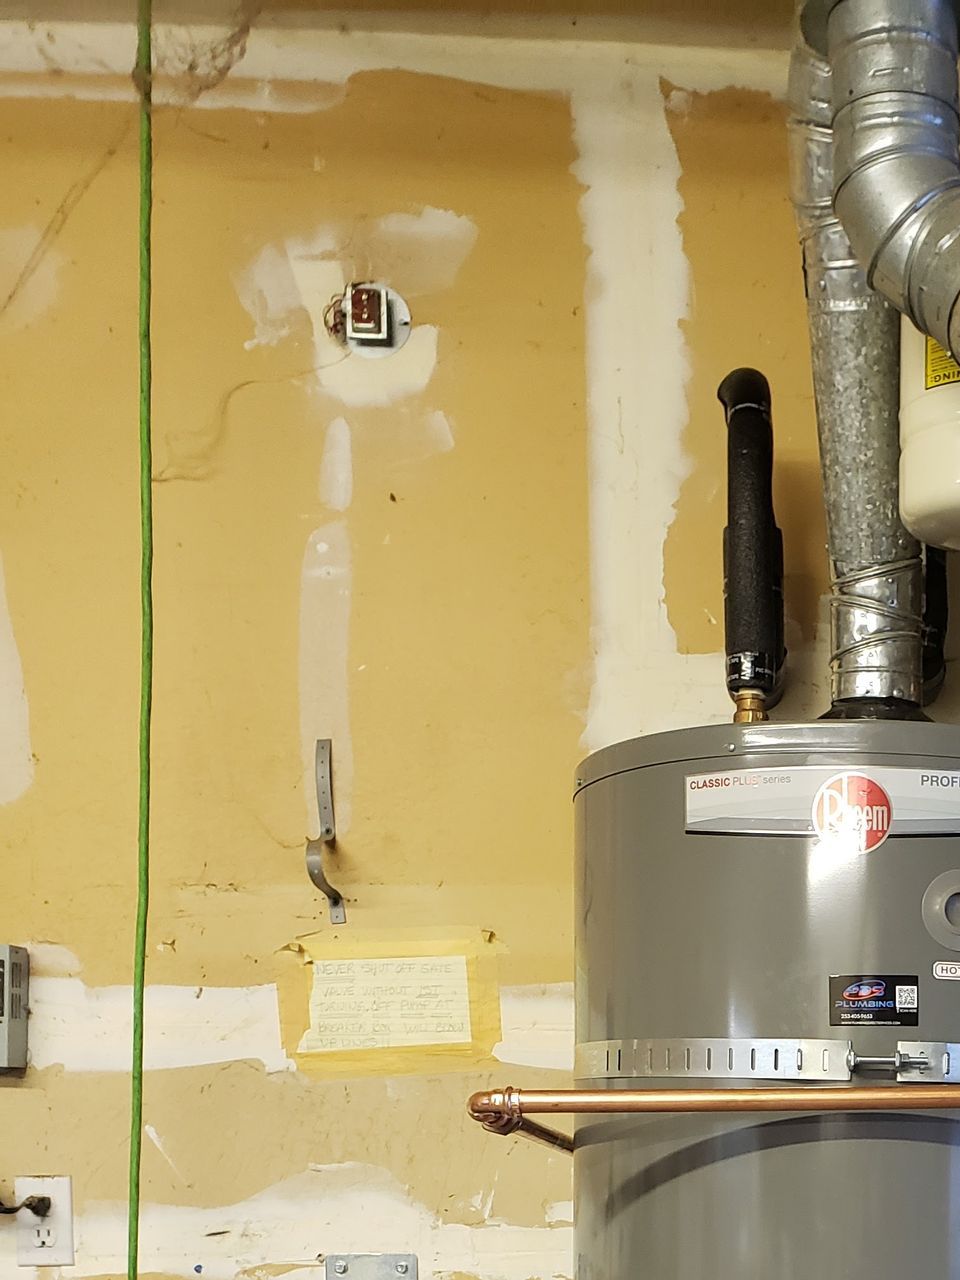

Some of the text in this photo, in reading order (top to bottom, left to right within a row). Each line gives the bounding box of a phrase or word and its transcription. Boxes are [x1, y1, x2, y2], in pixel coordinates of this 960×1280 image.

[689, 777, 731, 790] CLASSIC
[763, 774, 792, 785] series
[822, 776, 889, 833] Rheem
[314, 963, 355, 975] NEVER
[835, 1000, 895, 1008] PLUMBING
